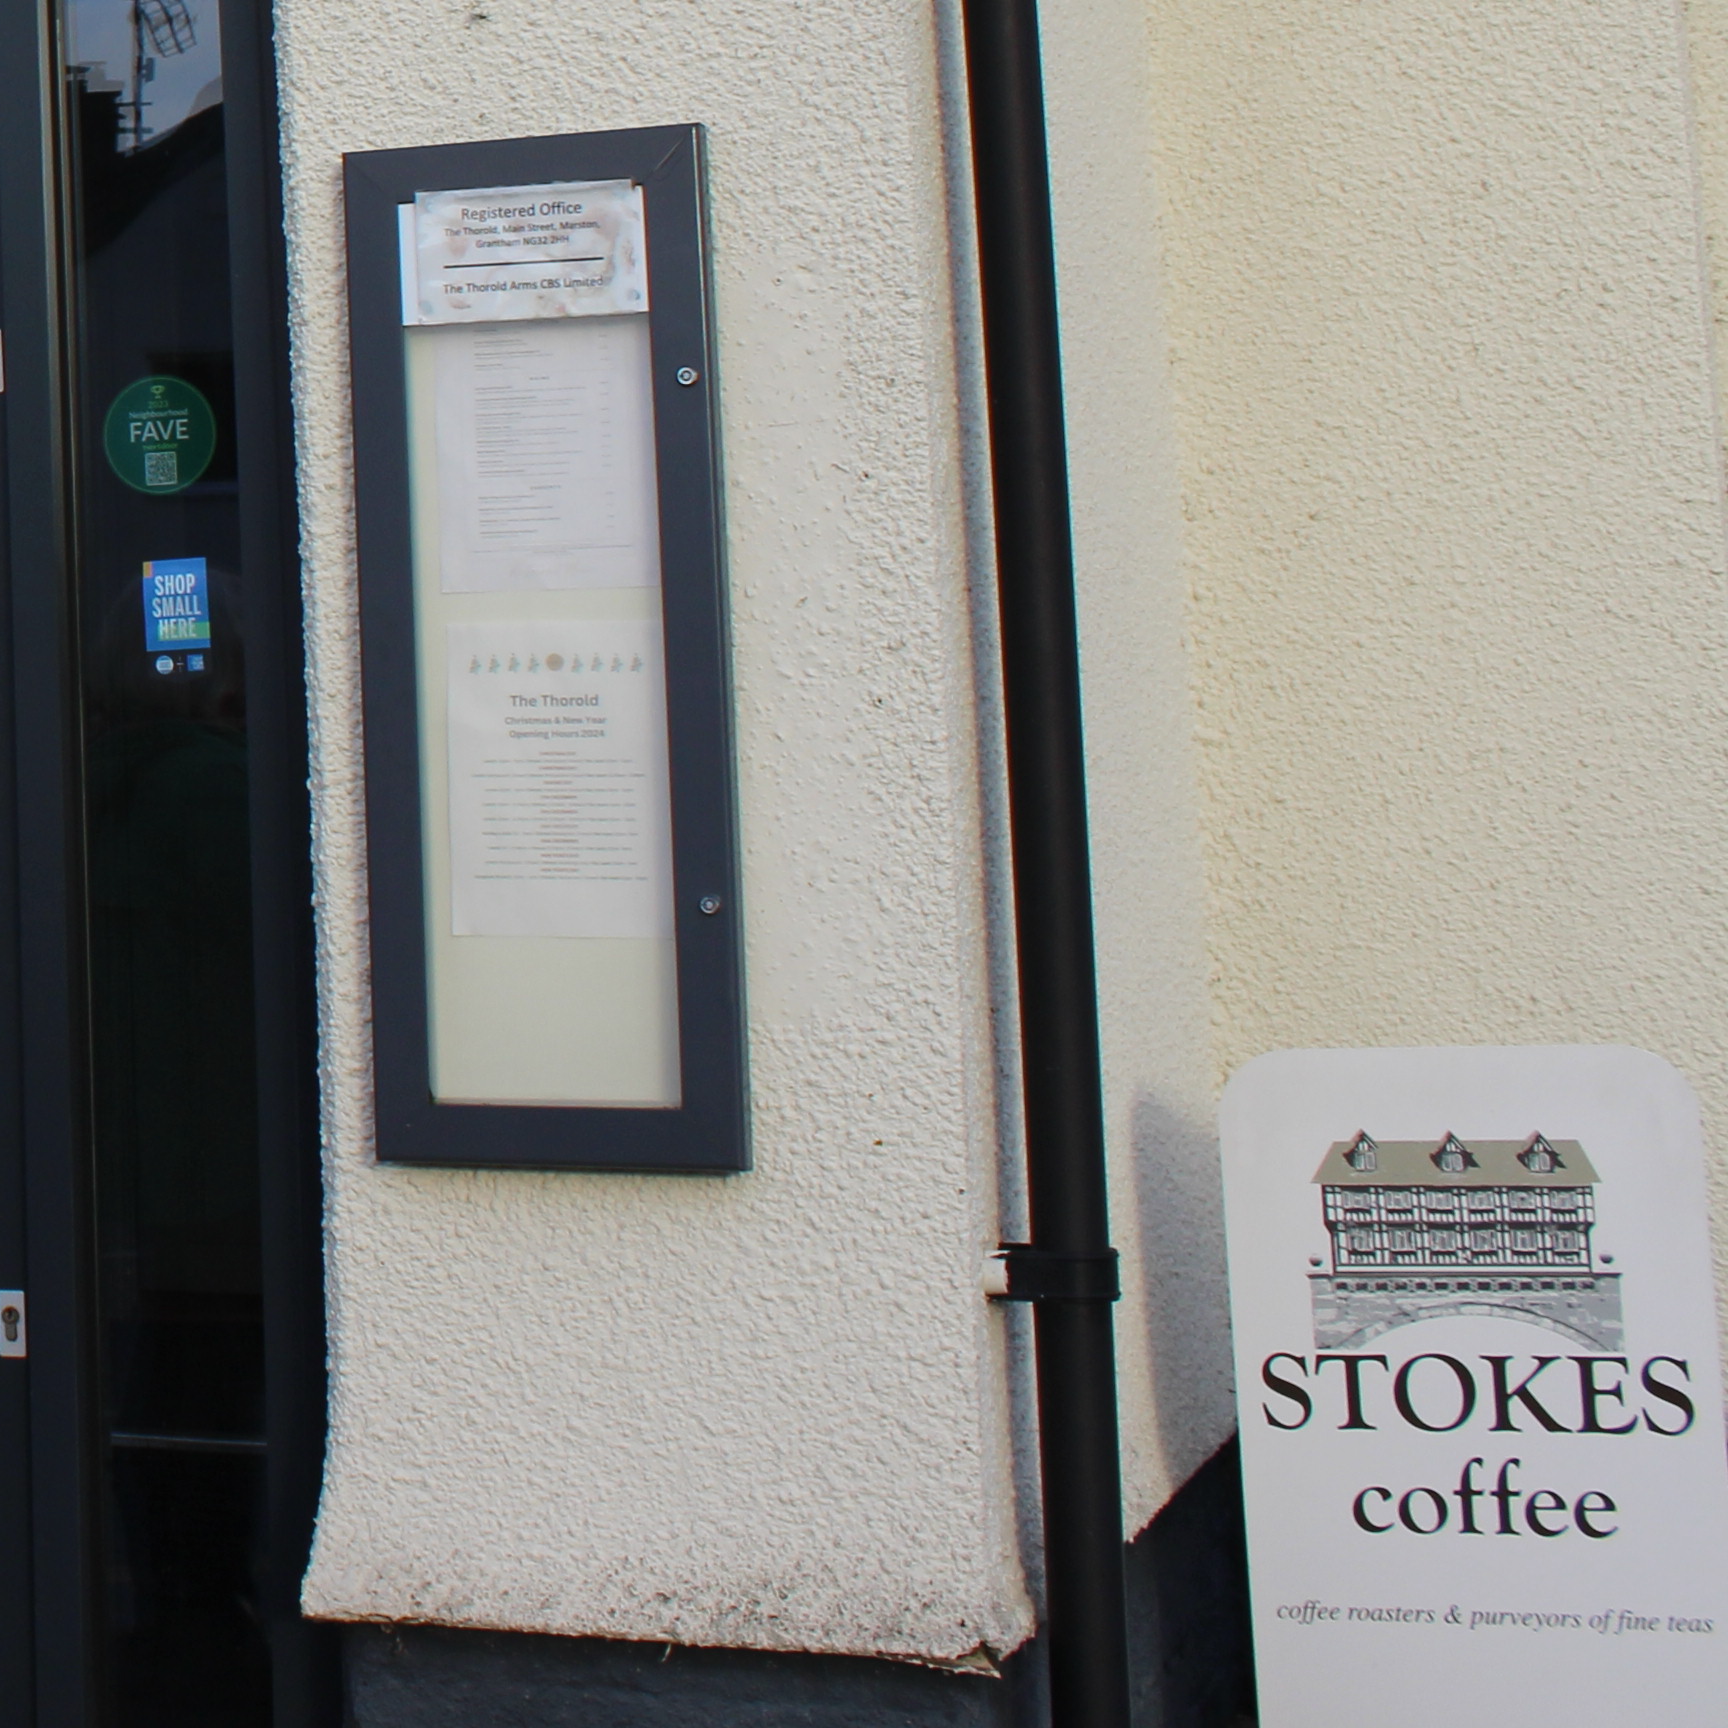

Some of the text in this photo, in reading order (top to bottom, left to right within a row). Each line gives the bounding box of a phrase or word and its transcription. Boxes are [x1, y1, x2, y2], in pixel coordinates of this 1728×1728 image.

[461, 201, 583, 221] Registered Office
[444, 227, 461, 237] The
[502, 224, 525, 233] Main
[475, 238, 521, 248] Grantham
[523, 237, 548, 246] NG32
[443, 276, 603, 294] The Thorold Arms CBS Limited
[129, 418, 190, 443] FAVE
[154, 573, 196, 596] SHOP
[152, 595, 202, 618] SMALL
[158, 617, 197, 639] HERE
[510, 694, 599, 707] The Thorold
[1262, 1353, 1697, 1436] STOKES
[1352, 1458, 1619, 1539] coffee
[1276, 1600, 1714, 1634] coffee roasters & purveyors of fine teas
